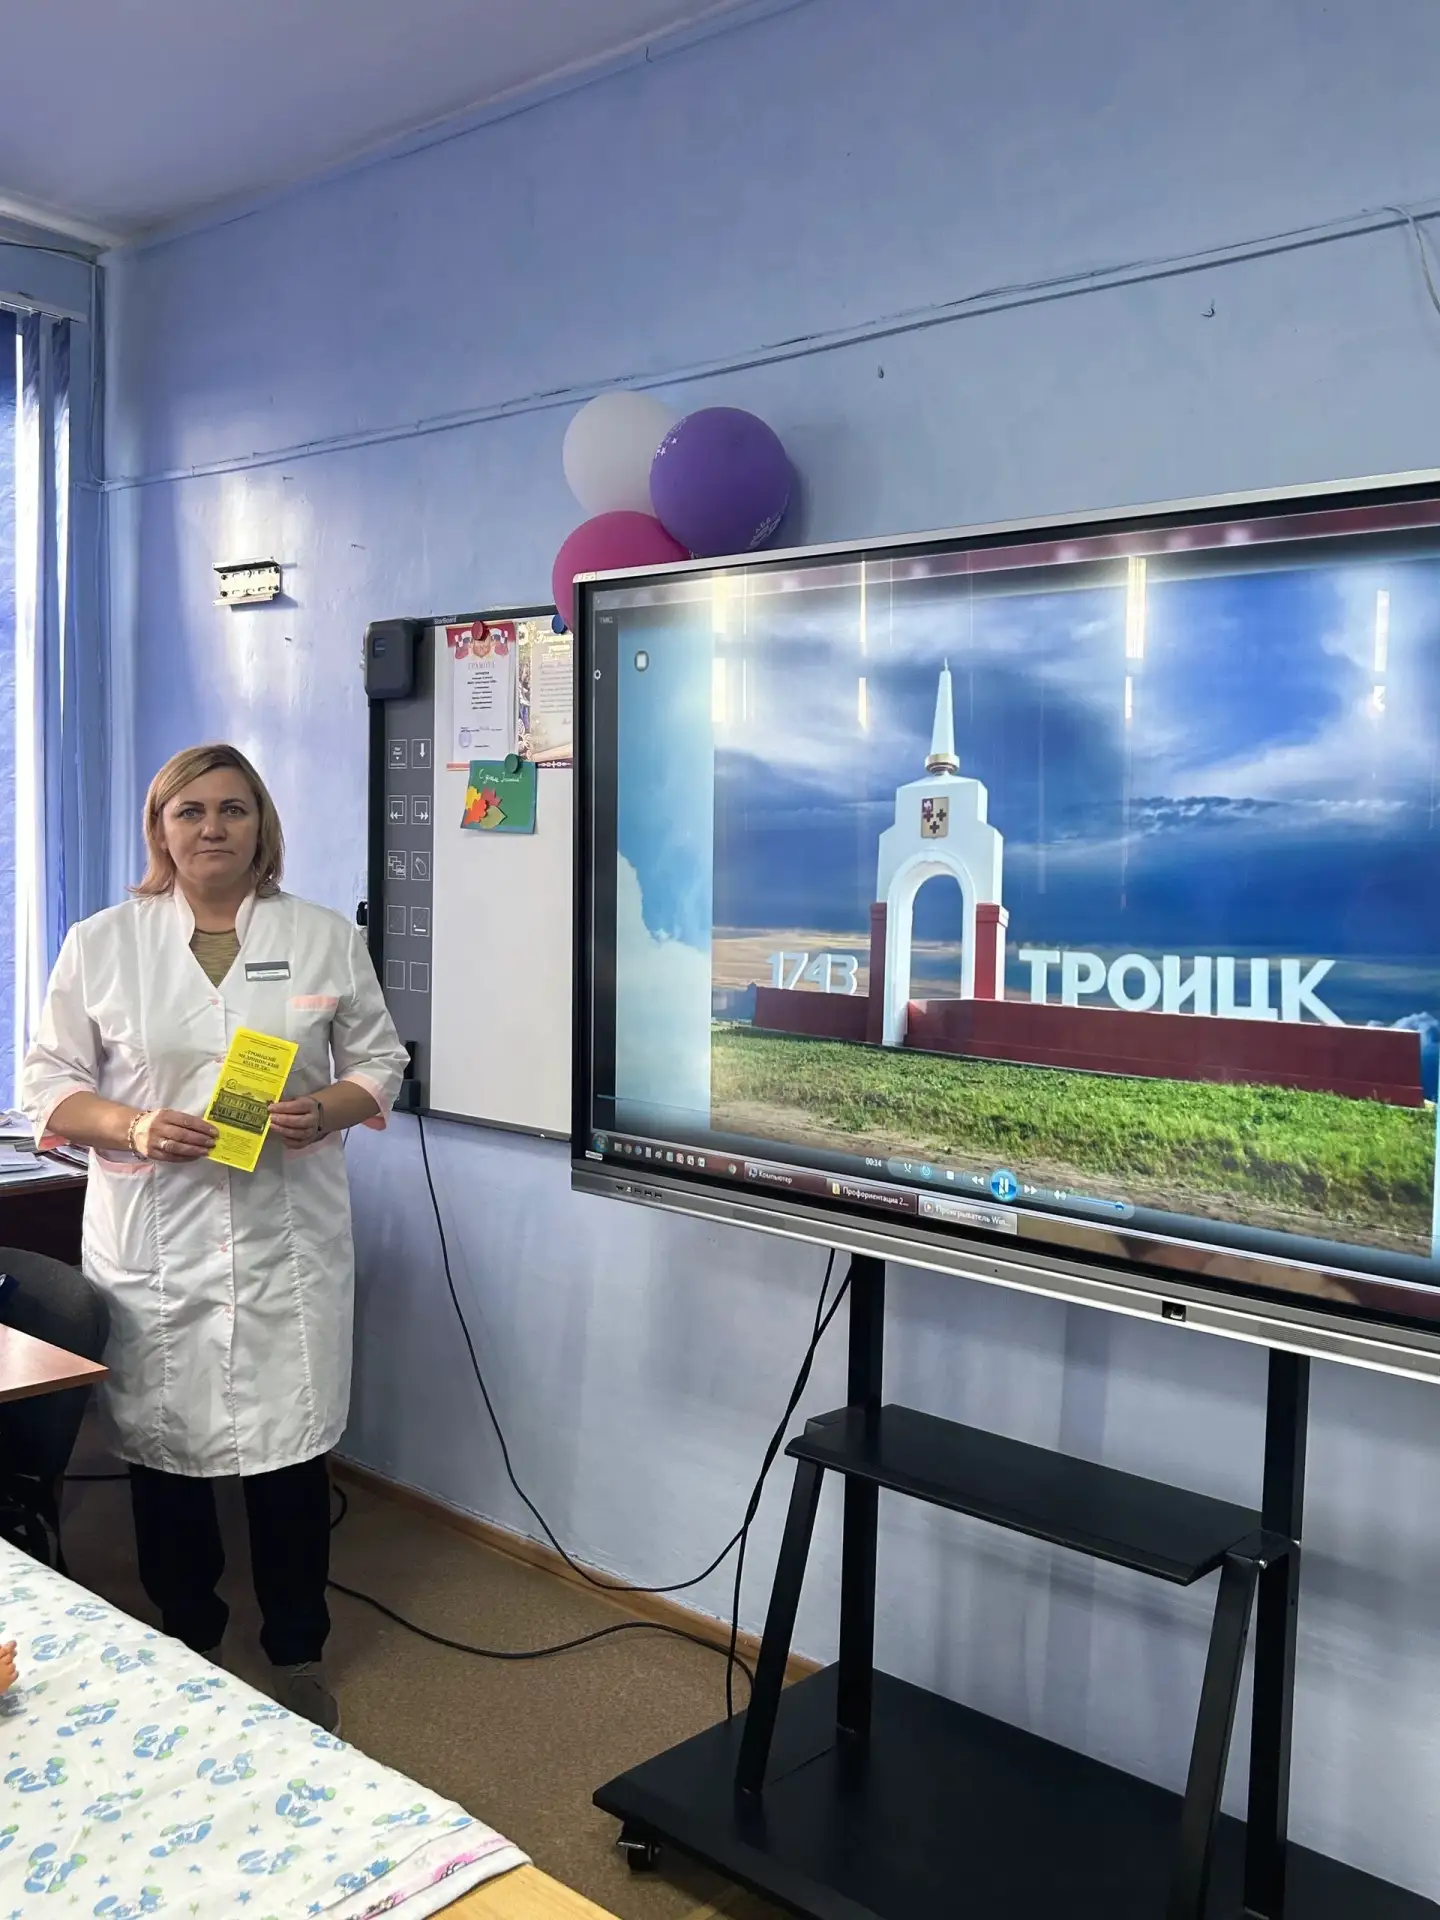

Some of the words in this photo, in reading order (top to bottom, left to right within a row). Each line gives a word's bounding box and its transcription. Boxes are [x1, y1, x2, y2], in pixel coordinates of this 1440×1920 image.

[766, 951, 860, 995] 1743
[1018, 948, 1345, 1025] ТРОИЦК
[758, 1170, 793, 1184] Компьютер
[842, 1186, 899, 1204] Профориентация
[935, 1204, 991, 1223] Проигрыватель
